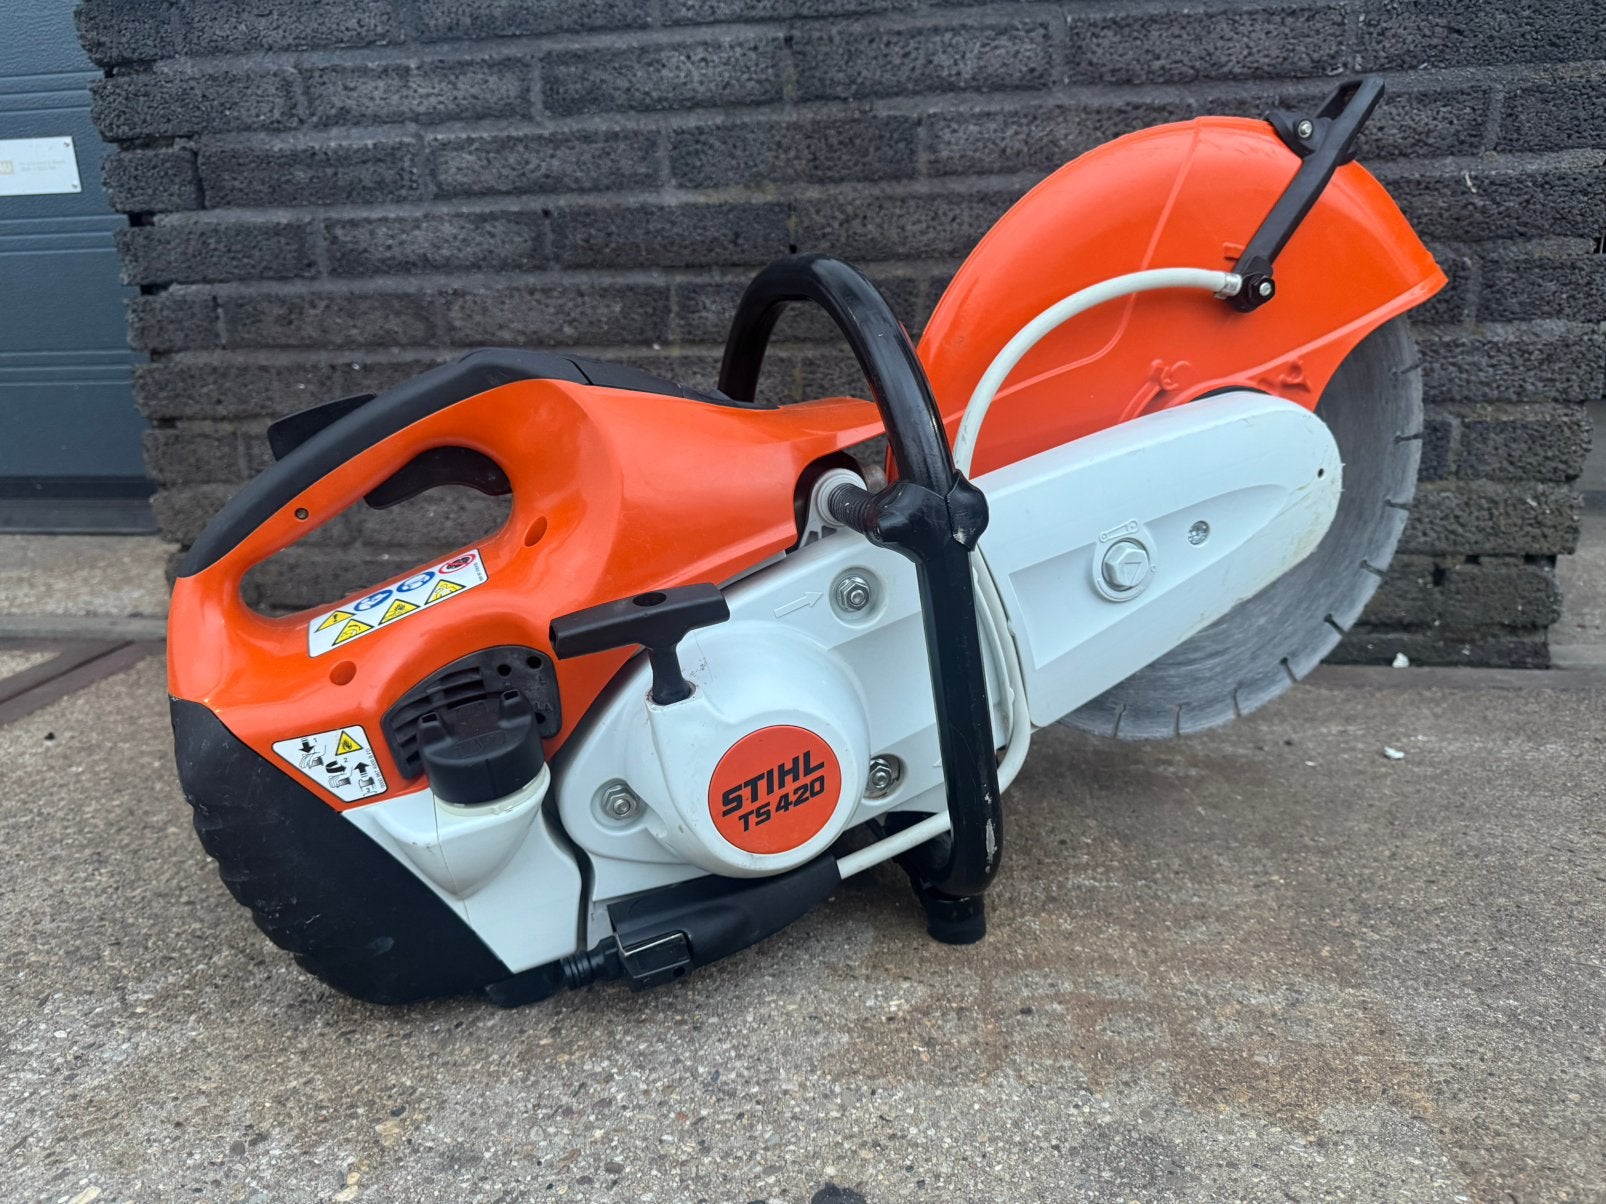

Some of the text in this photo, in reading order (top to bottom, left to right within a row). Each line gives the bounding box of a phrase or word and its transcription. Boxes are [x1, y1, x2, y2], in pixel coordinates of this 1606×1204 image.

[722, 749, 825, 818] STIHL
[738, 774, 825, 832] TS 420
